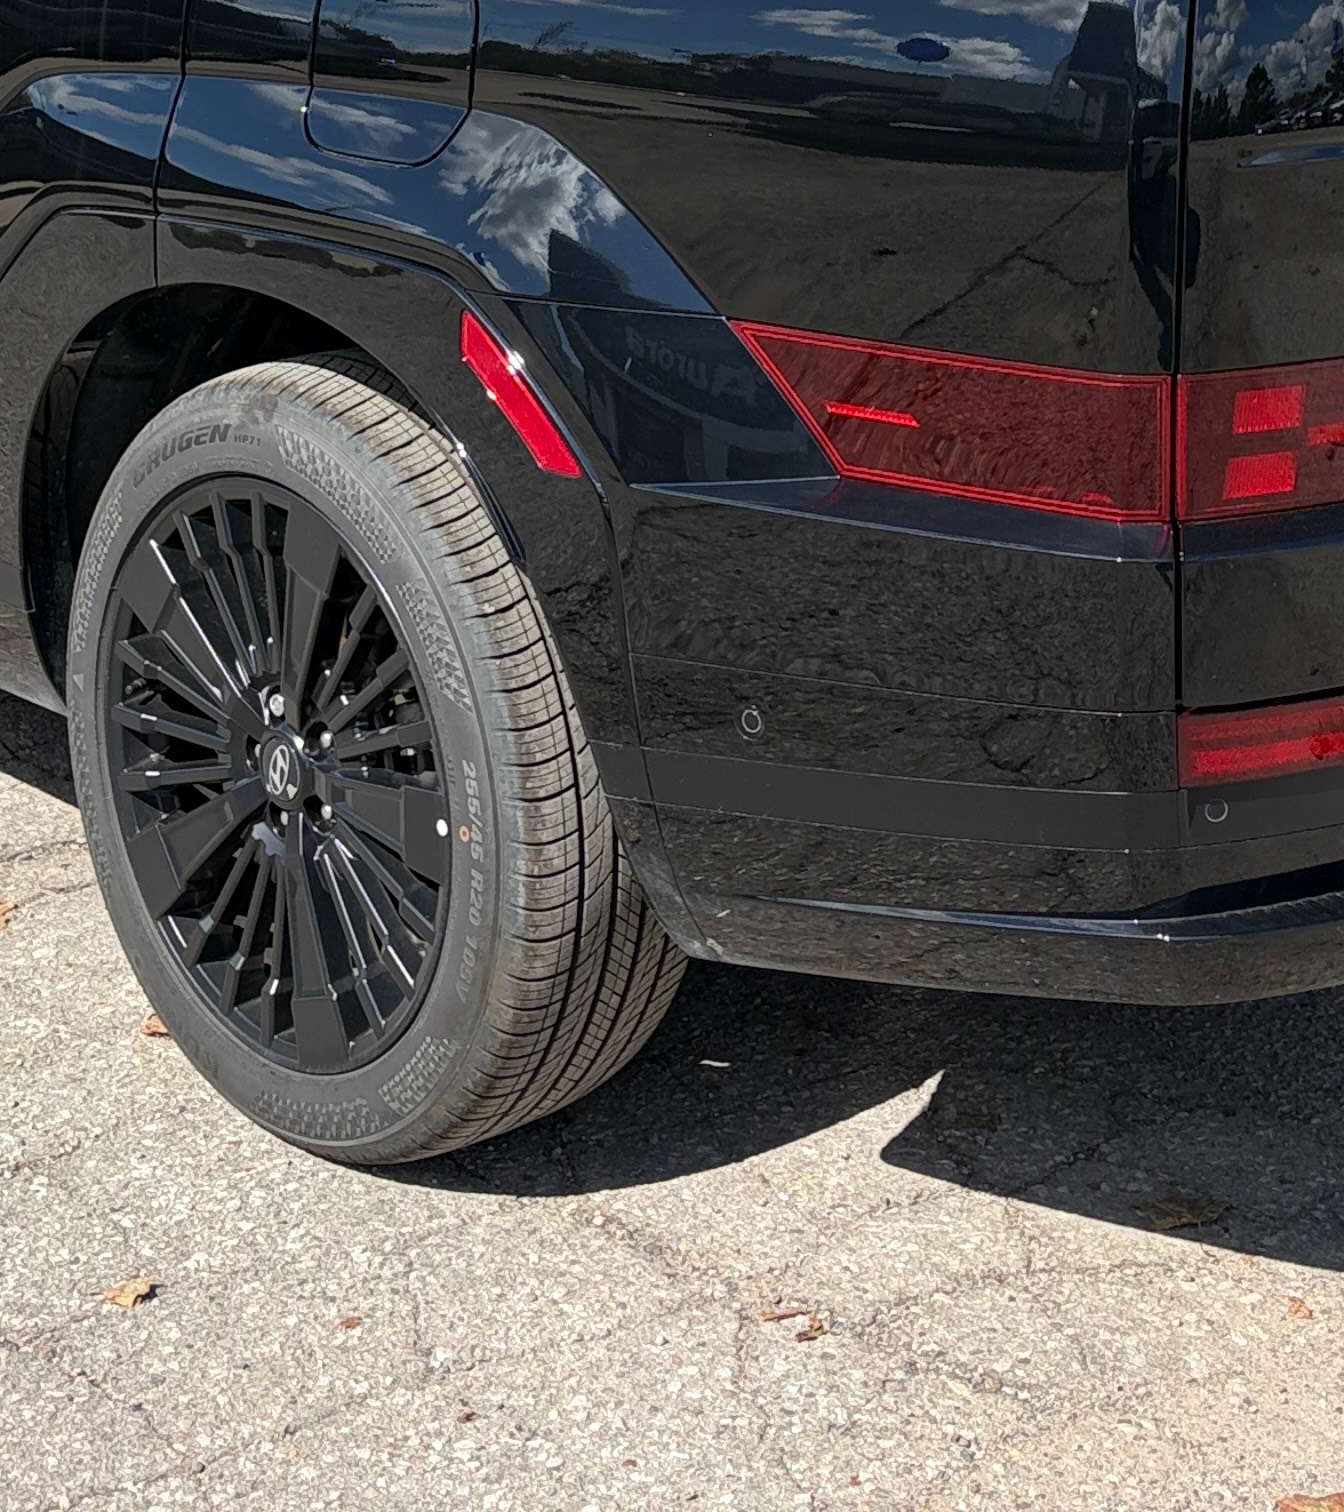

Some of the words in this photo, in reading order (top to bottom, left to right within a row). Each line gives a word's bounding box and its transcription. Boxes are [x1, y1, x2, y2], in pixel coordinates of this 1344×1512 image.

[133, 423, 233, 488] CRUGEN
[461, 759, 484, 862] 255/45
[468, 866, 484, 928] R20
